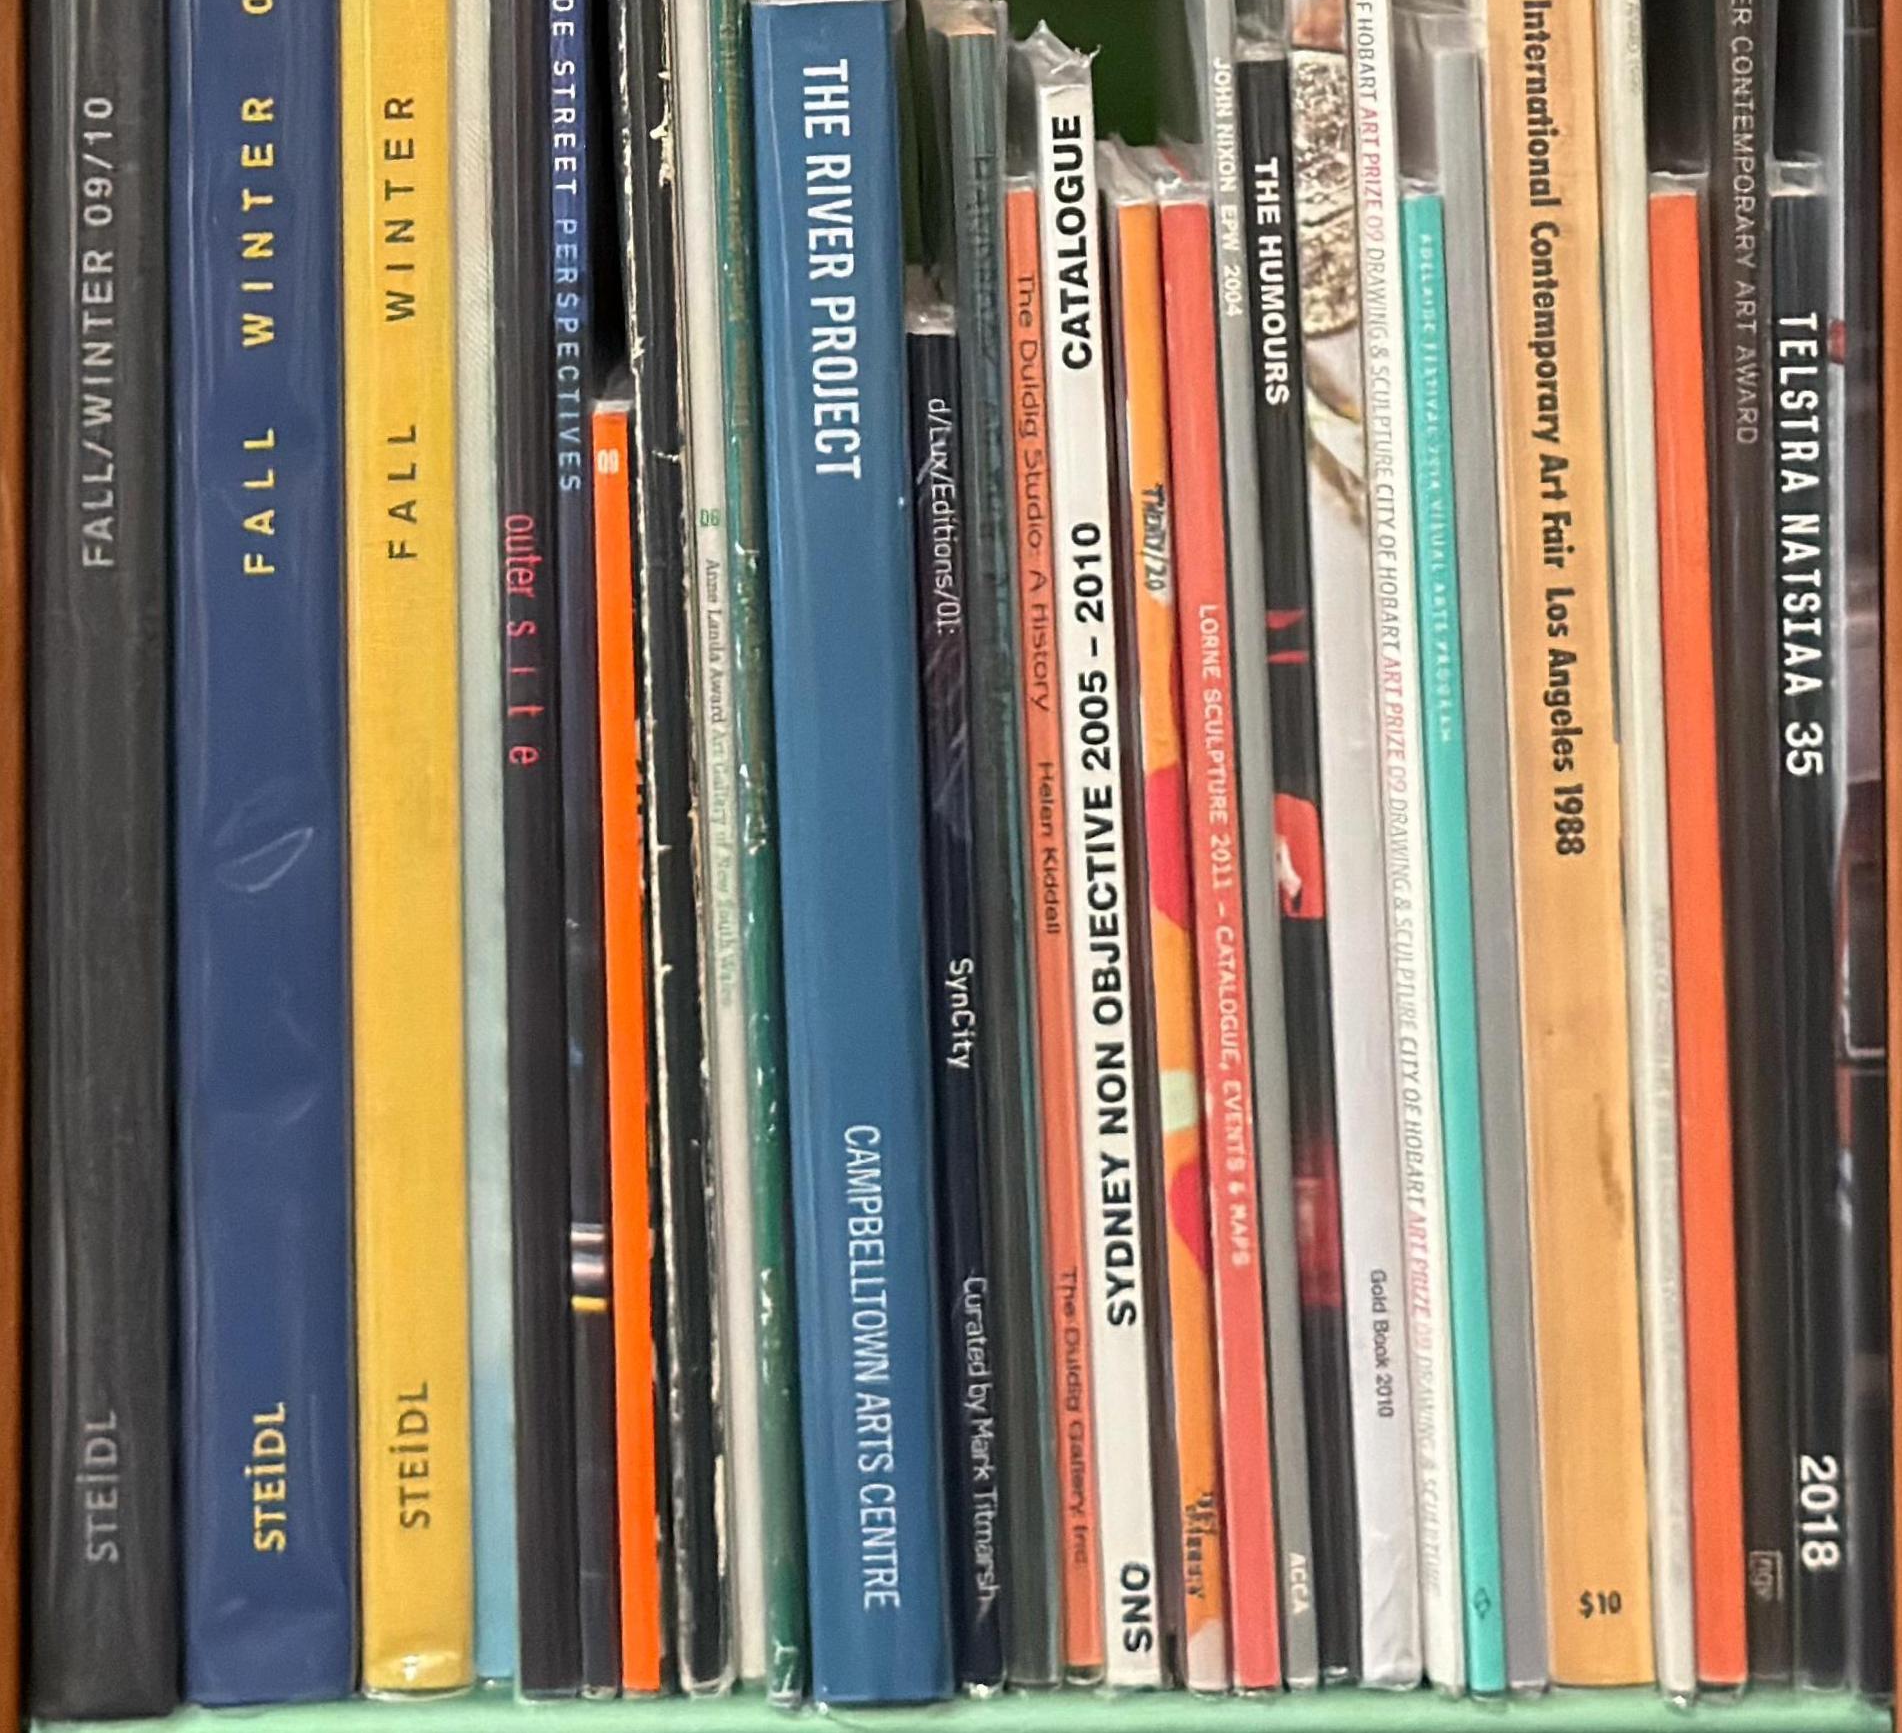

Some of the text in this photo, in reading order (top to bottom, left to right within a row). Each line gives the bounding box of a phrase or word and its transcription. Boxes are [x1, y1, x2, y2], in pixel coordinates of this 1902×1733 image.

[1358, 19, 1377, 102] HOBART
[1523, 0, 1561, 207] International
[83, 97, 114, 226] 09/10
[552, 61, 576, 194] STREET
[1361, 108, 1379, 146] ART
[1731, 36, 1755, 268] CONTEMPORARY
[240, 97, 275, 347] WINTER
[384, 98, 415, 322] WINTER
[1213, 57, 1242, 317] JOHN NIXON EPW 2004
[1363, 153, 1383, 208] PRIZE
[803, 58, 861, 478] THE RIVER PROJECT
[1051, 115, 1093, 369] CATALOGUE
[1366, 215, 1384, 241] 09
[1254, 157, 1289, 405] THE HUMOURS
[1366, 248, 1388, 342] DRAWING
[1735, 280, 1756, 334] ART
[555, 219, 580, 490] PERSPECTIVES
[1527, 221, 1562, 444] Contemporary
[1372, 366, 1393, 477] SCULPTURE
[1736, 345, 1758, 444] AWARD
[242, 429, 275, 574] FALL
[387, 425, 417, 559] FALL
[1376, 484, 1395, 529] CITY
[1539, 453, 1569, 500] Art
[505, 514, 543, 597] outer
[705, 559, 721, 603] Anne
[1071, 523, 1106, 623] 2010
[1378, 535, 1397, 560] OF
[1542, 511, 1574, 568] Fair
[1779, 312, 1824, 777] TELSTRA NATSIAA 35
[706, 610, 725, 661] Landa
[1018, 274, 1060, 934] The Duldig Studio: A History Helen Kiddell
[1199, 604, 1222, 679] LORNE
[1380, 569, 1399, 651] HOBART
[1546, 587, 1575, 637] Los
[709, 669, 726, 723] Award
[1078, 670, 1111, 770] 2005
[1383, 657, 1402, 696] ART
[1543, 648, 1582, 771] Angeles
[1203, 689, 1228, 823] SCULPTURE
[1385, 702, 1405, 760] PRIZE
[1211, 834, 1232, 889] 2011
[1390, 798, 1410, 889] DRAWING
[1554, 784, 1585, 855] 1988
[1083, 785, 1122, 1025] OBJECTIVE
[945, 958, 975, 1068] SynCity
[1213, 925, 1238, 1069] CATALOGUE,
[1394, 918, 1417, 1029] SCULPTURE
[1096, 1041, 1128, 1134] NON
[1399, 1037, 1418, 1083] CITY
[1403, 1087, 1421, 1114] OF
[1221, 1080, 1244, 1170] EVENTS
[1405, 1121, 1425, 1205] HOBART
[1100, 1151, 1137, 1326] SYDNEY
[1231, 1203, 1249, 1267] MAPS
[1060, 1267, 1077, 1317] The
[844, 1125, 900, 1610] CAMPBELLTOWN ARTS CENTRE
[1370, 1269, 1394, 1418] Gold Book 2010
[963, 1277, 1000, 1600] Curated by Mark Titmarsh
[1068, 1421, 1086, 1514] Gallery
[1800, 1454, 1840, 1570] 2018
[1120, 1563, 1152, 1653] SNO
[1289, 1553, 1310, 1614] ACCA
[1578, 1589, 1622, 1619] $10
